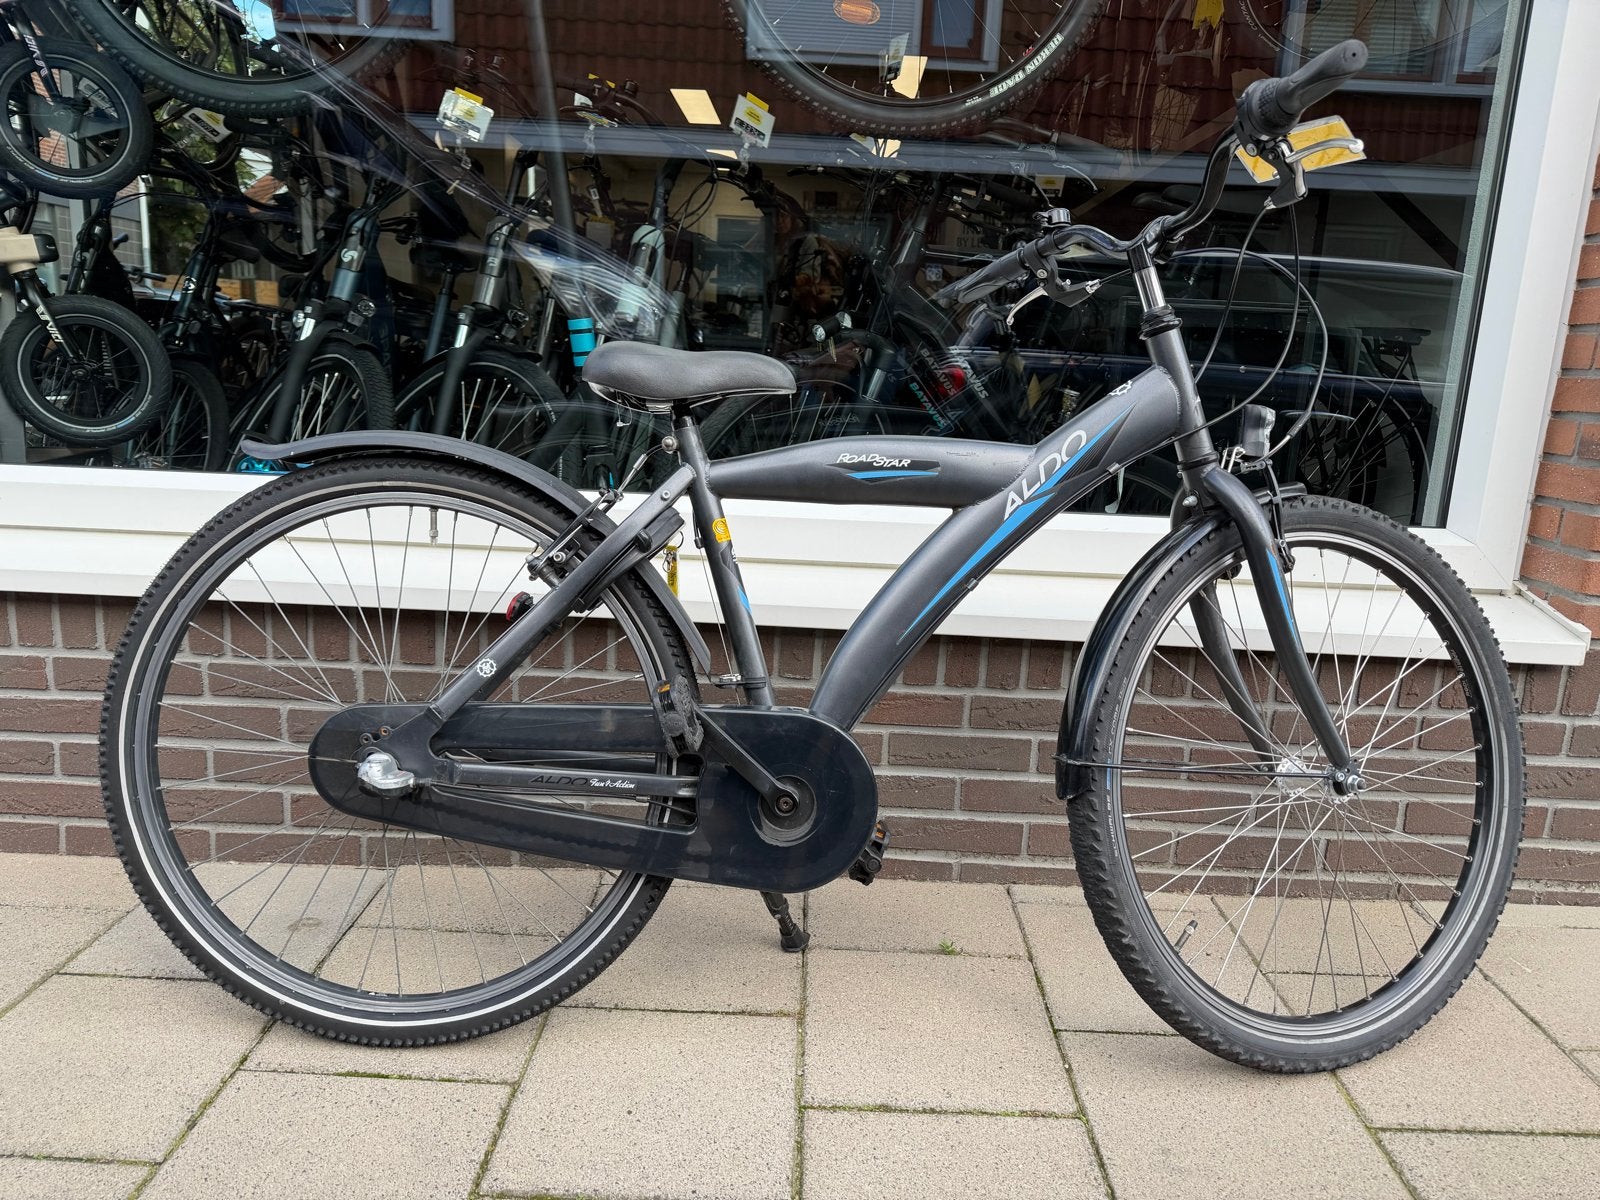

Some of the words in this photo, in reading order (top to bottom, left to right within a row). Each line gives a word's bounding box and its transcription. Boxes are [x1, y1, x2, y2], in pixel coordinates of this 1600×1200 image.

[920, 347, 958, 397] BATAVUS
[909, 381, 948, 431] BATAVUS
[836, 452, 911, 468] ROADSTAR
[1003, 429, 1087, 521] ALDO
[530, 774, 588, 786] ALDO
